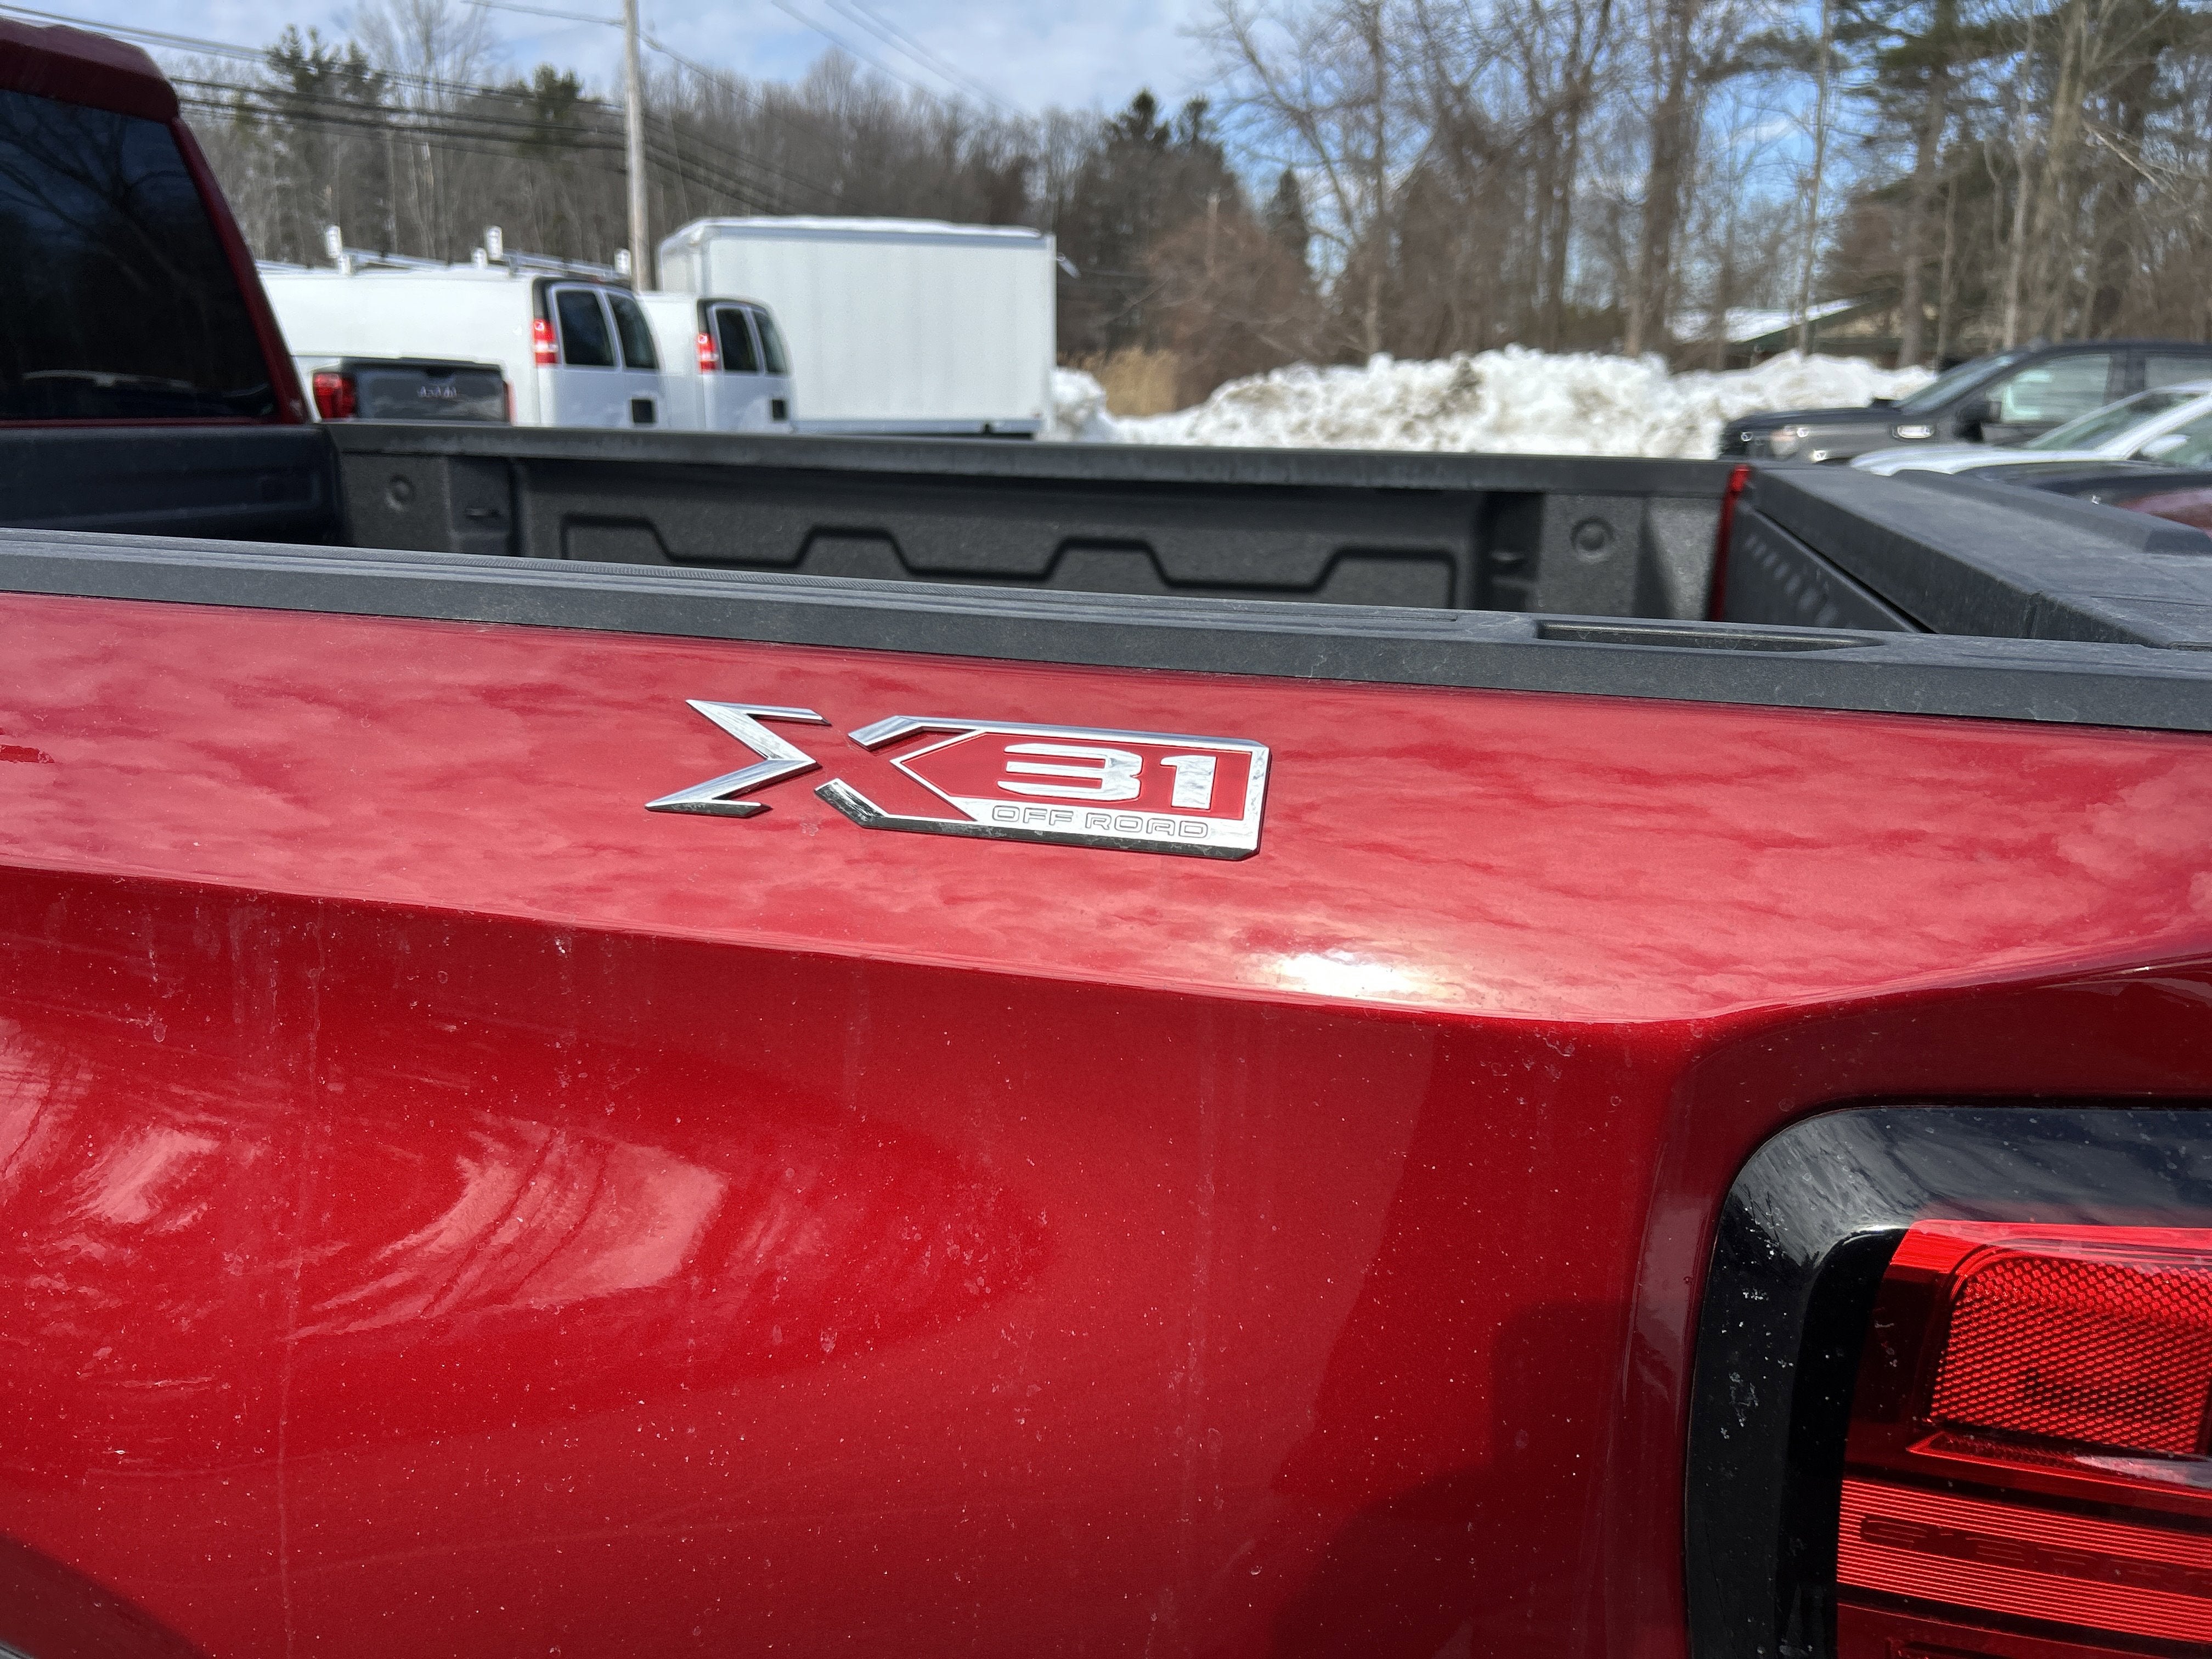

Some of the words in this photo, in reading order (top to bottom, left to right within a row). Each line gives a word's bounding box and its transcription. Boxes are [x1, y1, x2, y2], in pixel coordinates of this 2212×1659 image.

[645, 699, 1218, 828] X31
[991, 804, 1074, 826] OFF
[1085, 811, 1209, 839] ROAD
